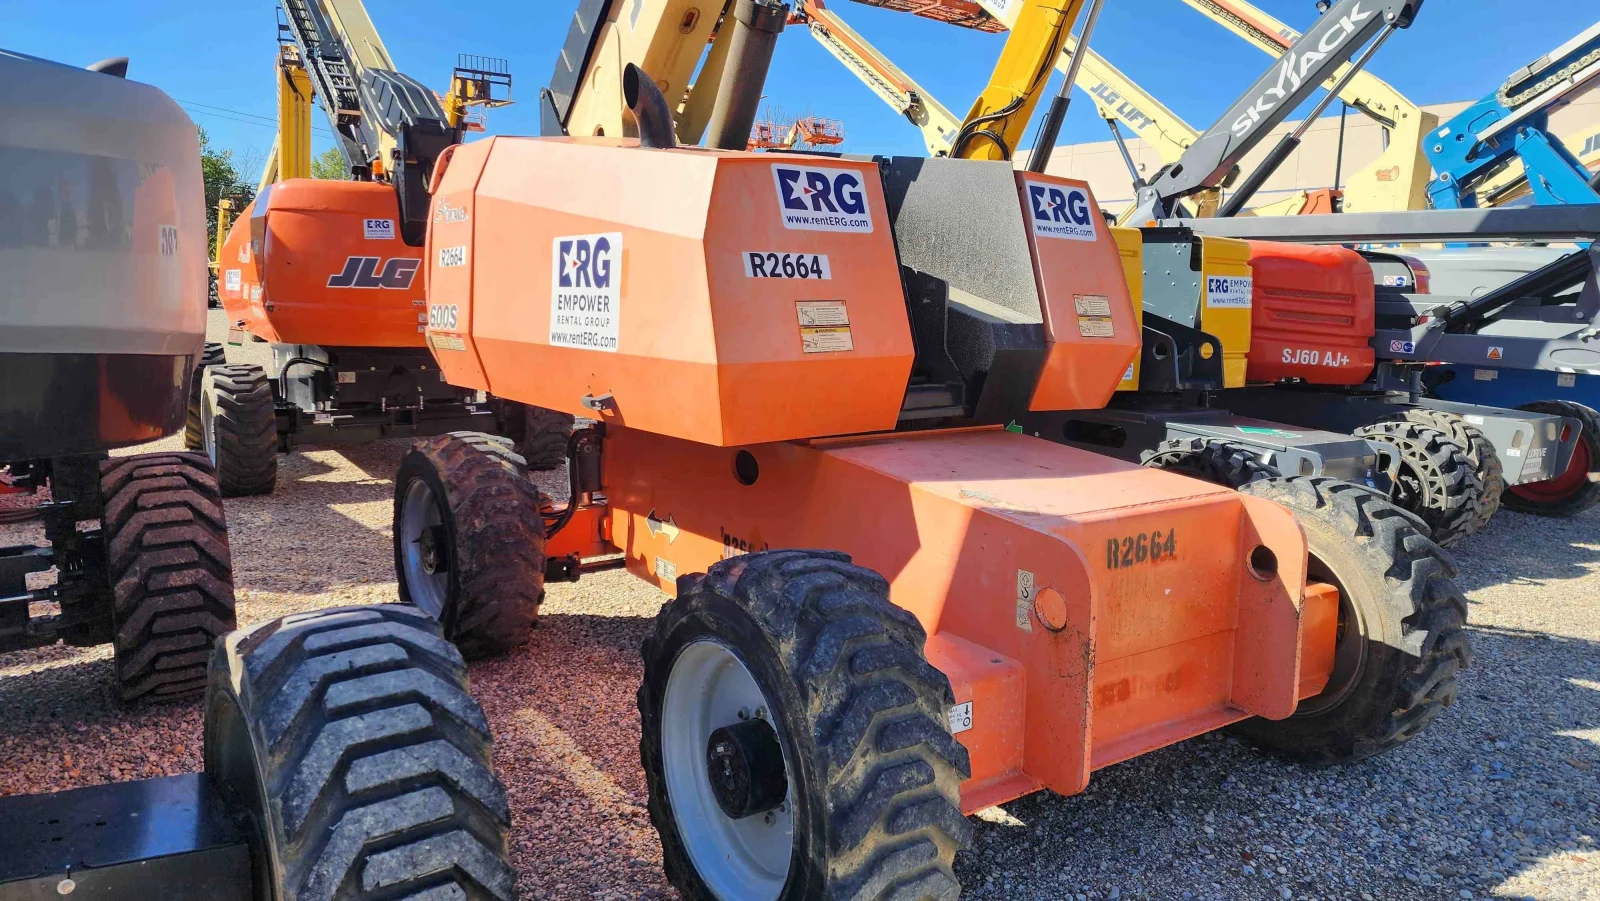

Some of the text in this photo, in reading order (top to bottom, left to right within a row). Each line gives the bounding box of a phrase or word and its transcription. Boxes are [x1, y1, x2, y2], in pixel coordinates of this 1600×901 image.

[1231, 1, 1373, 138] SKYJACK
[1089, 82, 1154, 130] JLG LIFT
[776, 168, 866, 215] ERG
[1029, 185, 1091, 226] ERG
[366, 220, 390, 229] ERG
[786, 215, 869, 228] www.rentERG.com
[1036, 225, 1094, 237] www.rentERG.com
[441, 246, 463, 267] R2664
[559, 236, 611, 289] ERG
[749, 252, 823, 279] R2664
[326, 256, 422, 290] JLG
[1208, 278, 1229, 294] ERG
[558, 294, 610, 312] EMPOWER
[430, 304, 457, 329] 600S
[557, 315, 610, 328] RENTAL GROUP
[551, 332, 617, 348] www.rentERG.com
[1282, 348, 1350, 367] SJ60 AJ+
[1107, 528, 1176, 569] R2664
